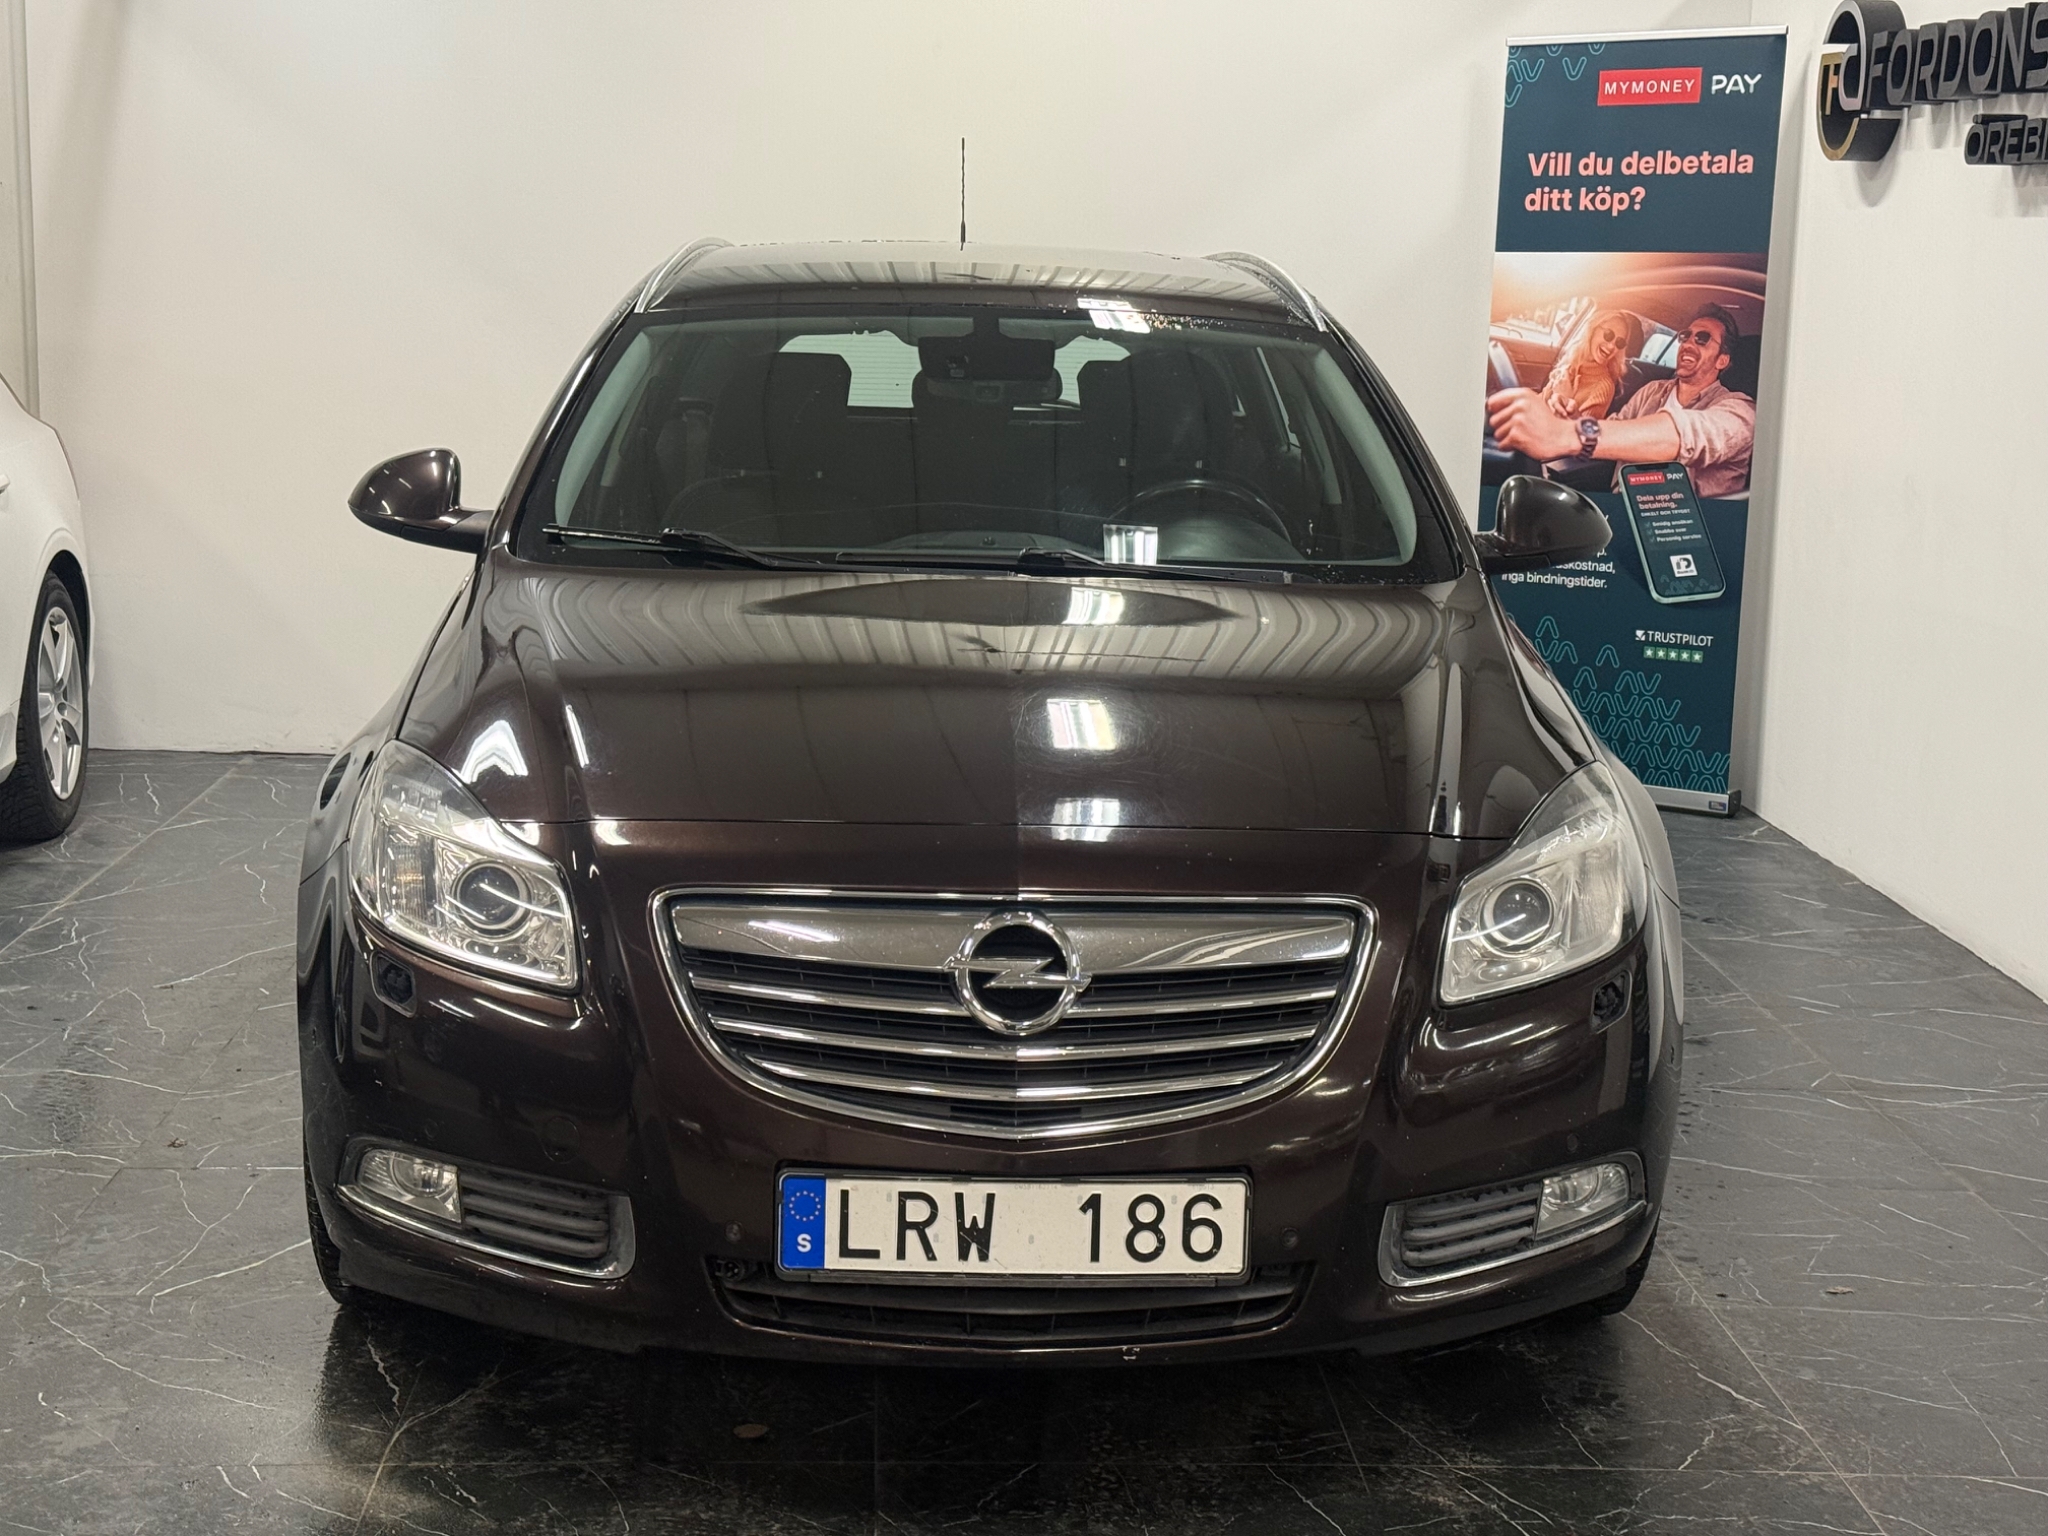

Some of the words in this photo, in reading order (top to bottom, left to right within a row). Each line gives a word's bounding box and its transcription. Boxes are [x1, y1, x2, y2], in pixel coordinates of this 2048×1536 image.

[1866, 2, 2048, 108] FORDONS
[1603, 78, 1696, 96] MYMONEY
[1711, 73, 1762, 95] PAY
[1965, 114, 2048, 165] ÖREB
[1528, 152, 1571, 177] Vill
[1578, 151, 1613, 176] du
[1620, 149, 1754, 176] delbetala
[1524, 188, 1572, 212] ditt
[1578, 186, 1646, 216] köp?
[1666, 472, 1684, 480] PAY
[1671, 491, 1684, 499] din
[1526, 572, 1607, 588] bindningstider.
[1647, 630, 1714, 647] TRUSTPILOT
[838, 1189, 996, 1262] LRW
[1079, 1193, 1223, 1263] 186
[796, 1234, 812, 1252] S
